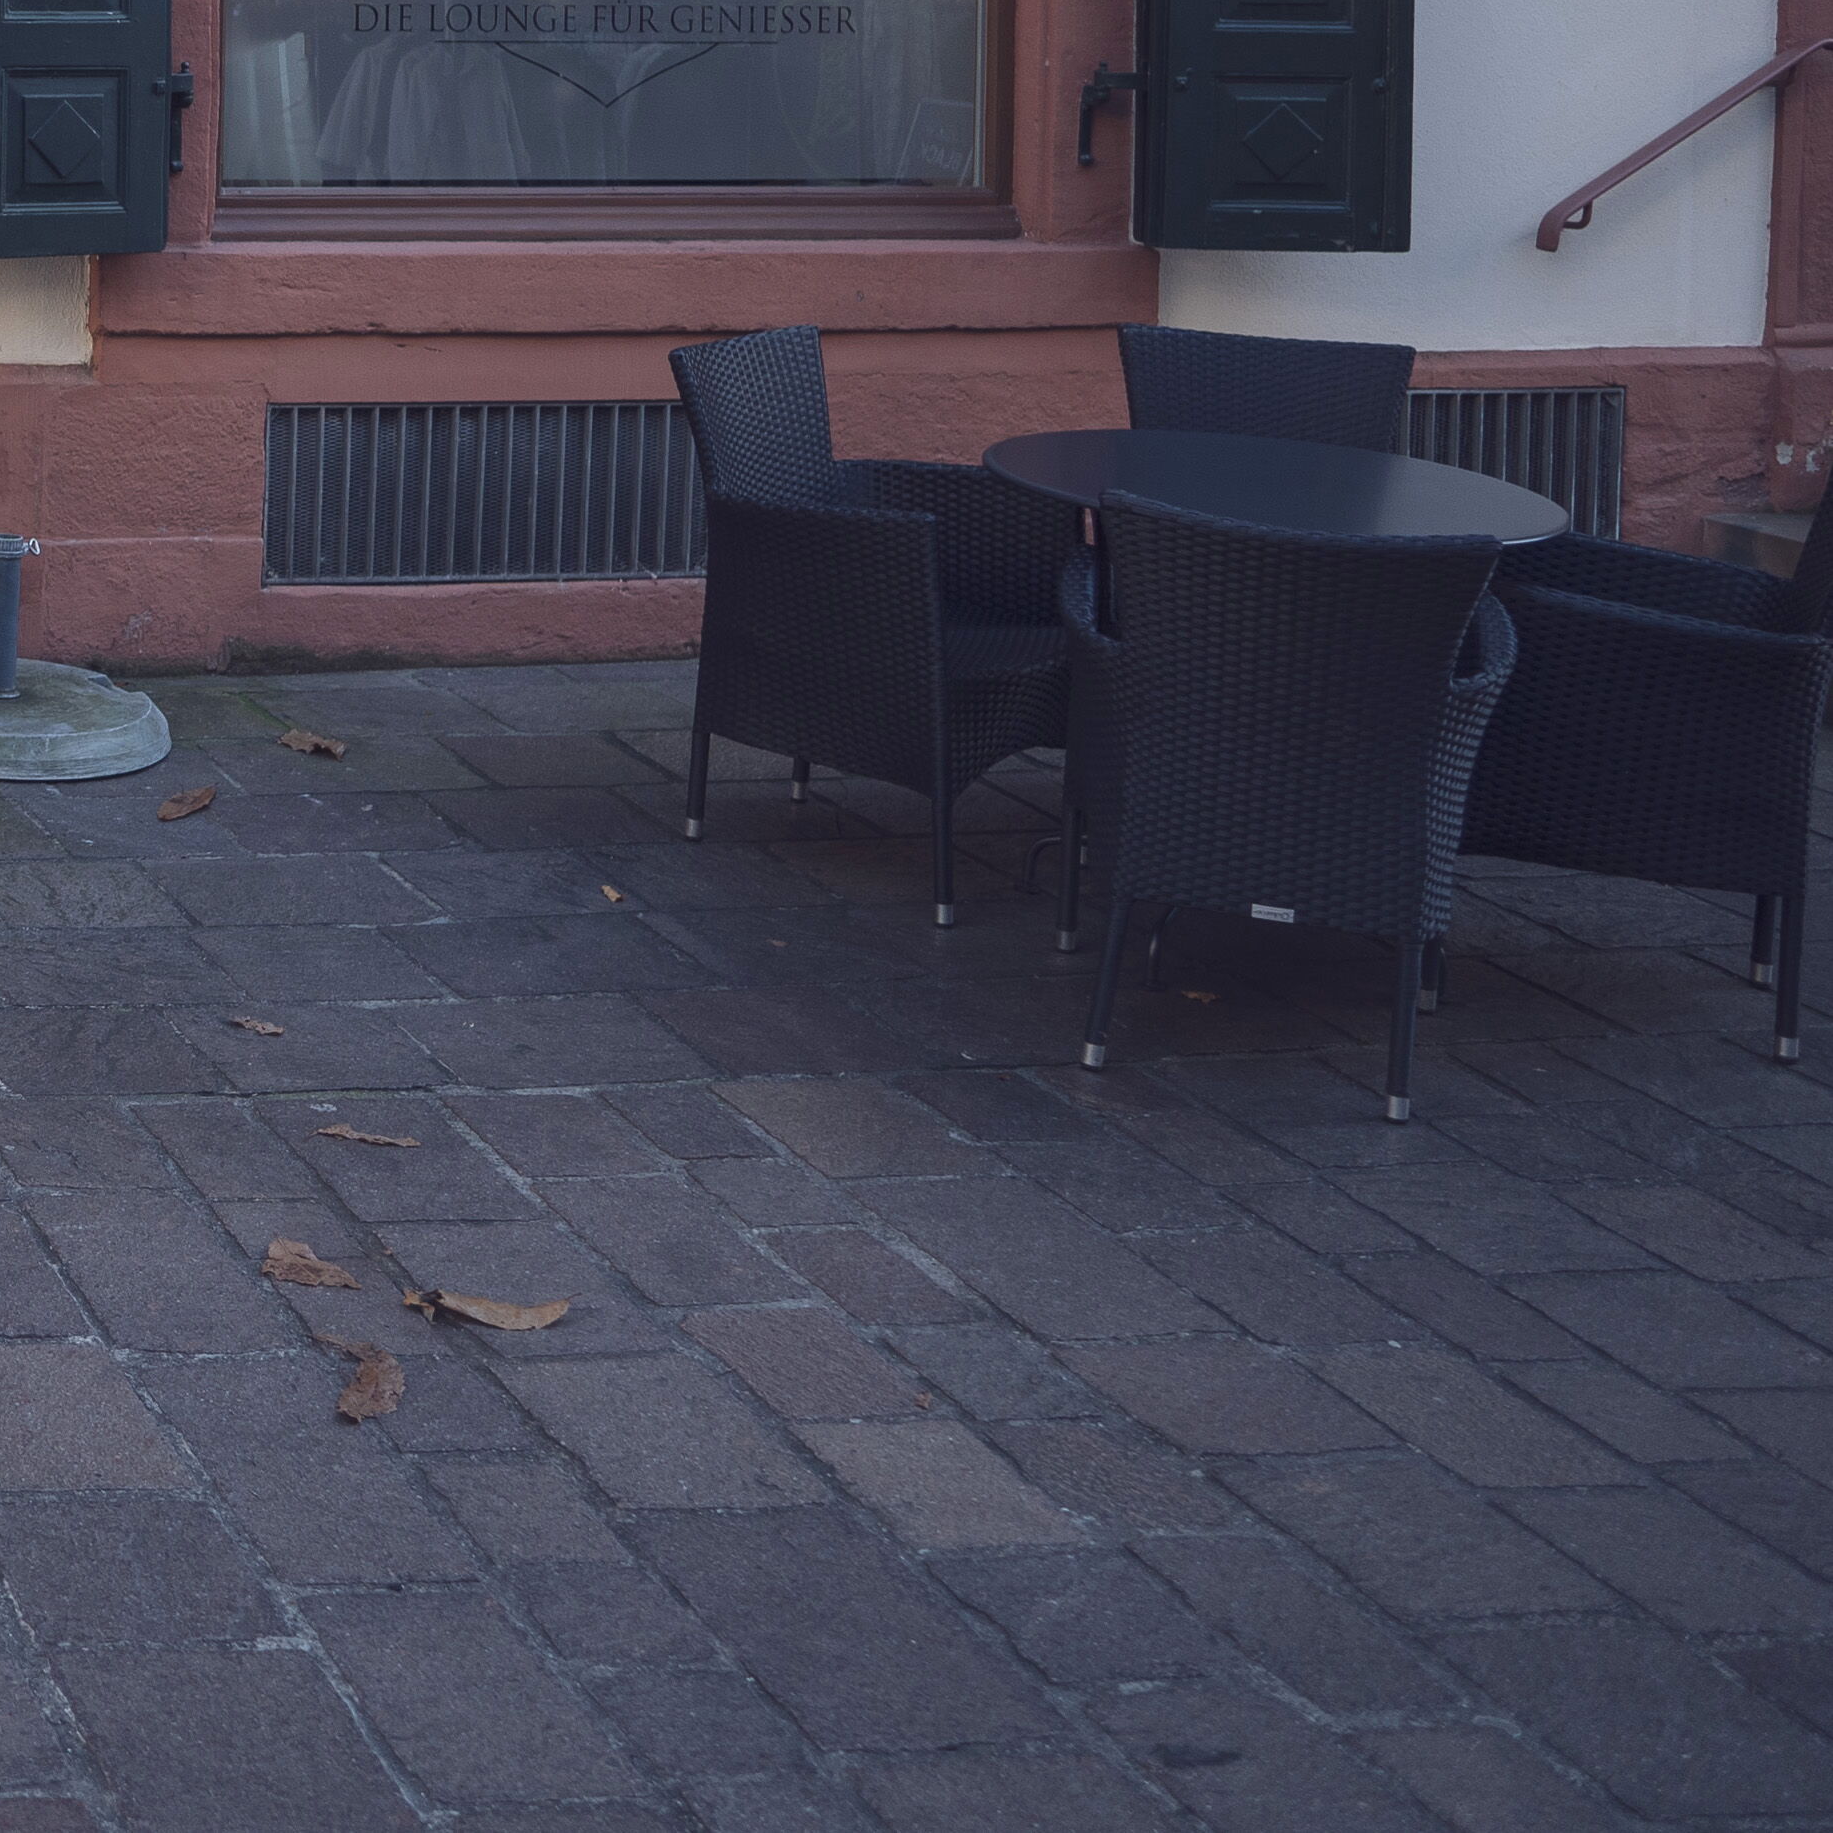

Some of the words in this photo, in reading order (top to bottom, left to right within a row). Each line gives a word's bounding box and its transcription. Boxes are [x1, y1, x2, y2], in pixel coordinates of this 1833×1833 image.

[353, 3, 413, 33] DIE
[429, 3, 578, 33] LOUNGE
[593, 0, 660, 34] FÜR
[670, 3, 857, 35] GENIESSER
